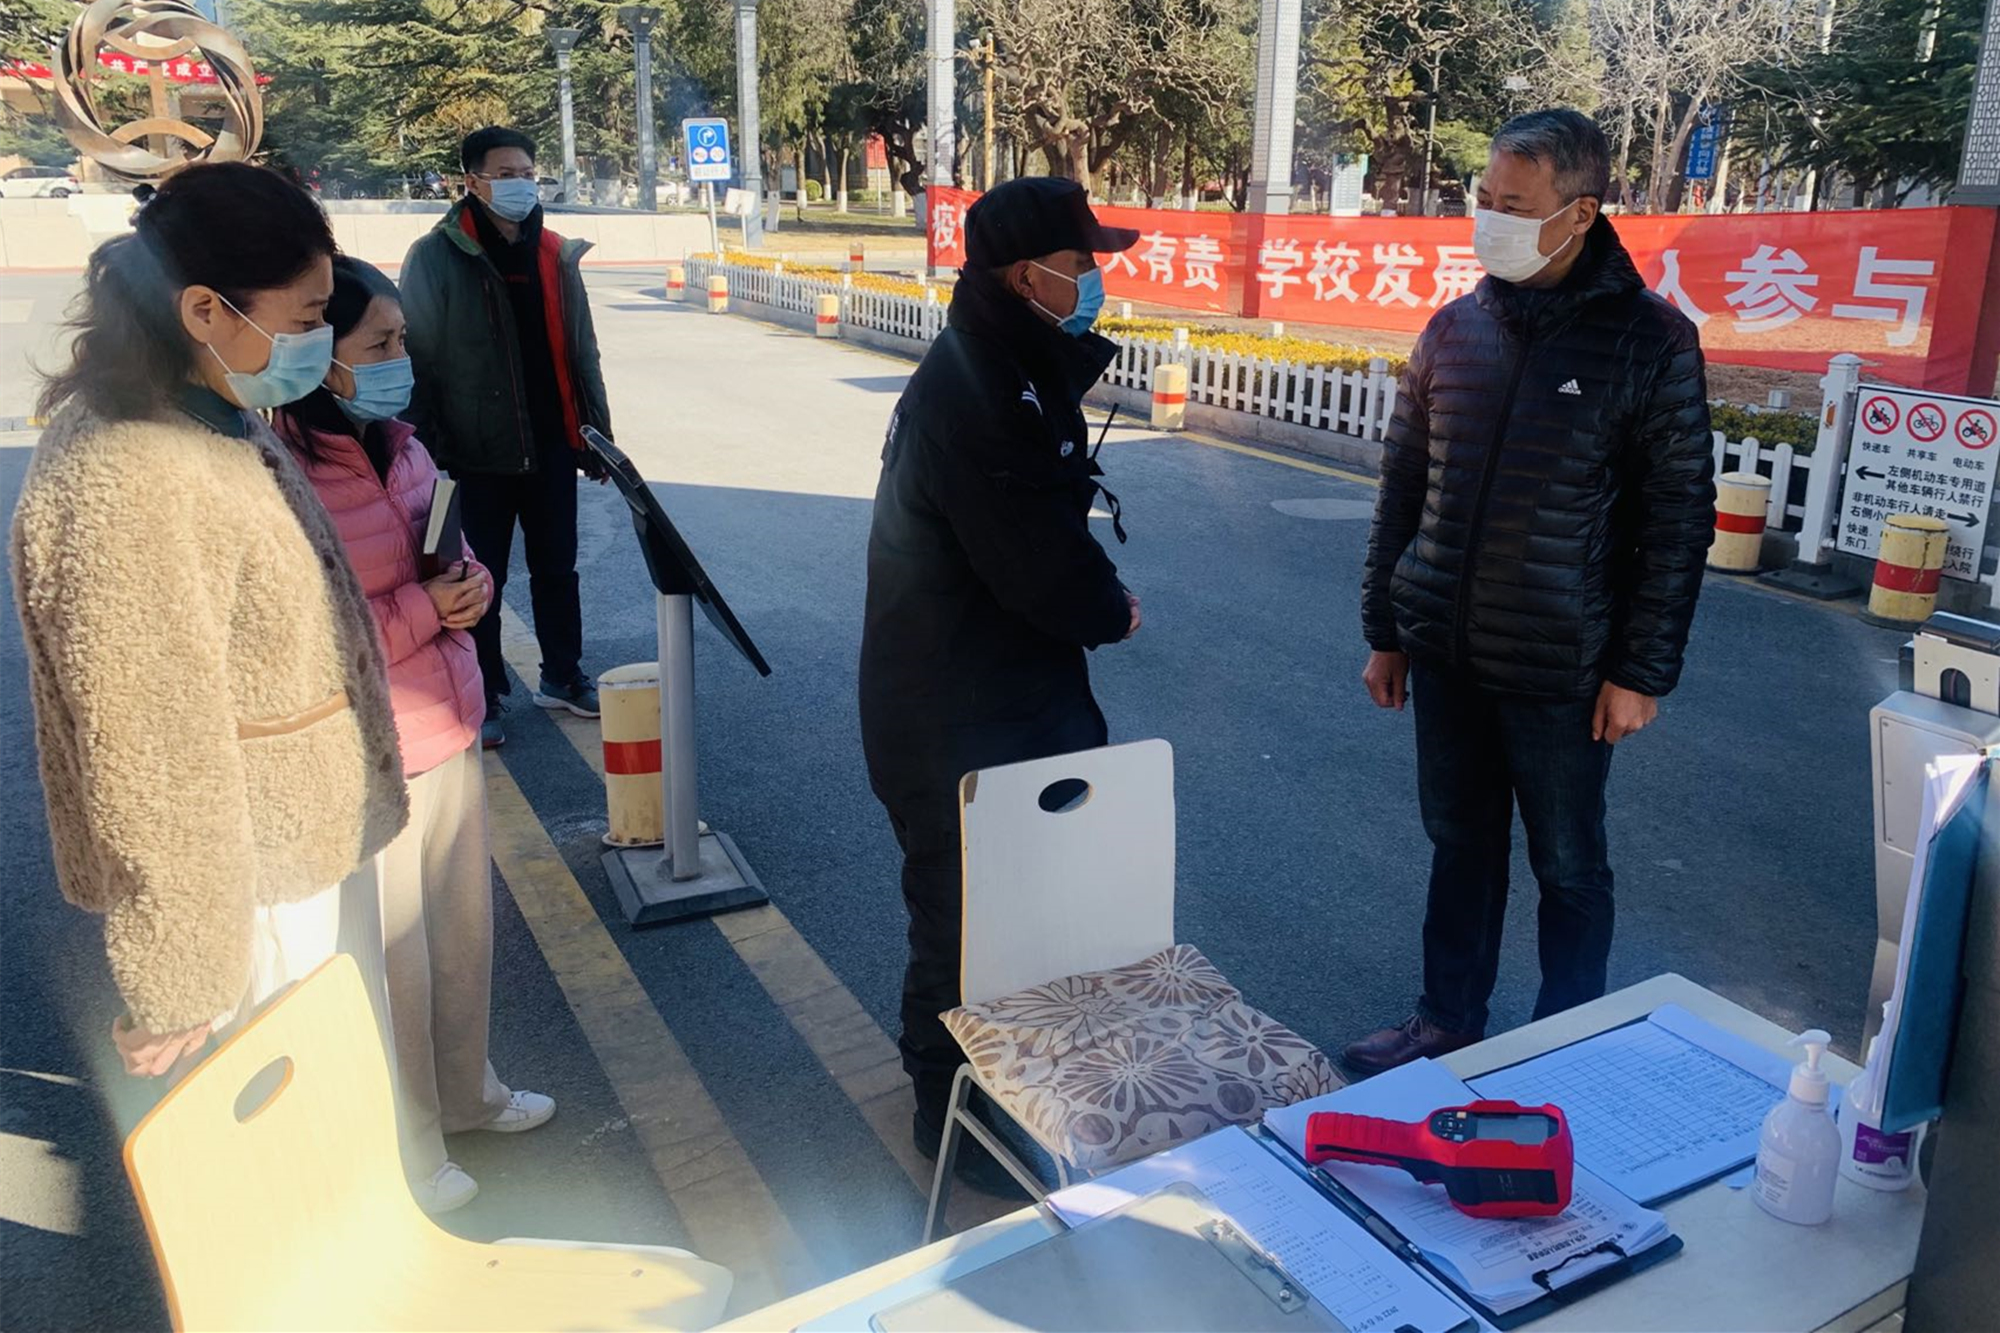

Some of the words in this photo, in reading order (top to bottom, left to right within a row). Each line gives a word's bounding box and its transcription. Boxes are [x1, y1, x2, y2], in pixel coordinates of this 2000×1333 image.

[1862, 441, 1892, 455] 快递车
[1906, 448, 1938, 462] 共享车
[1952, 457, 1985, 471] 电动车
[1888, 465, 1987, 494] 左侧机动车专用道
[1885, 479, 1984, 508] 其他车辆行人禁行
[1852, 491, 1947, 520] 非机动车行人请走
